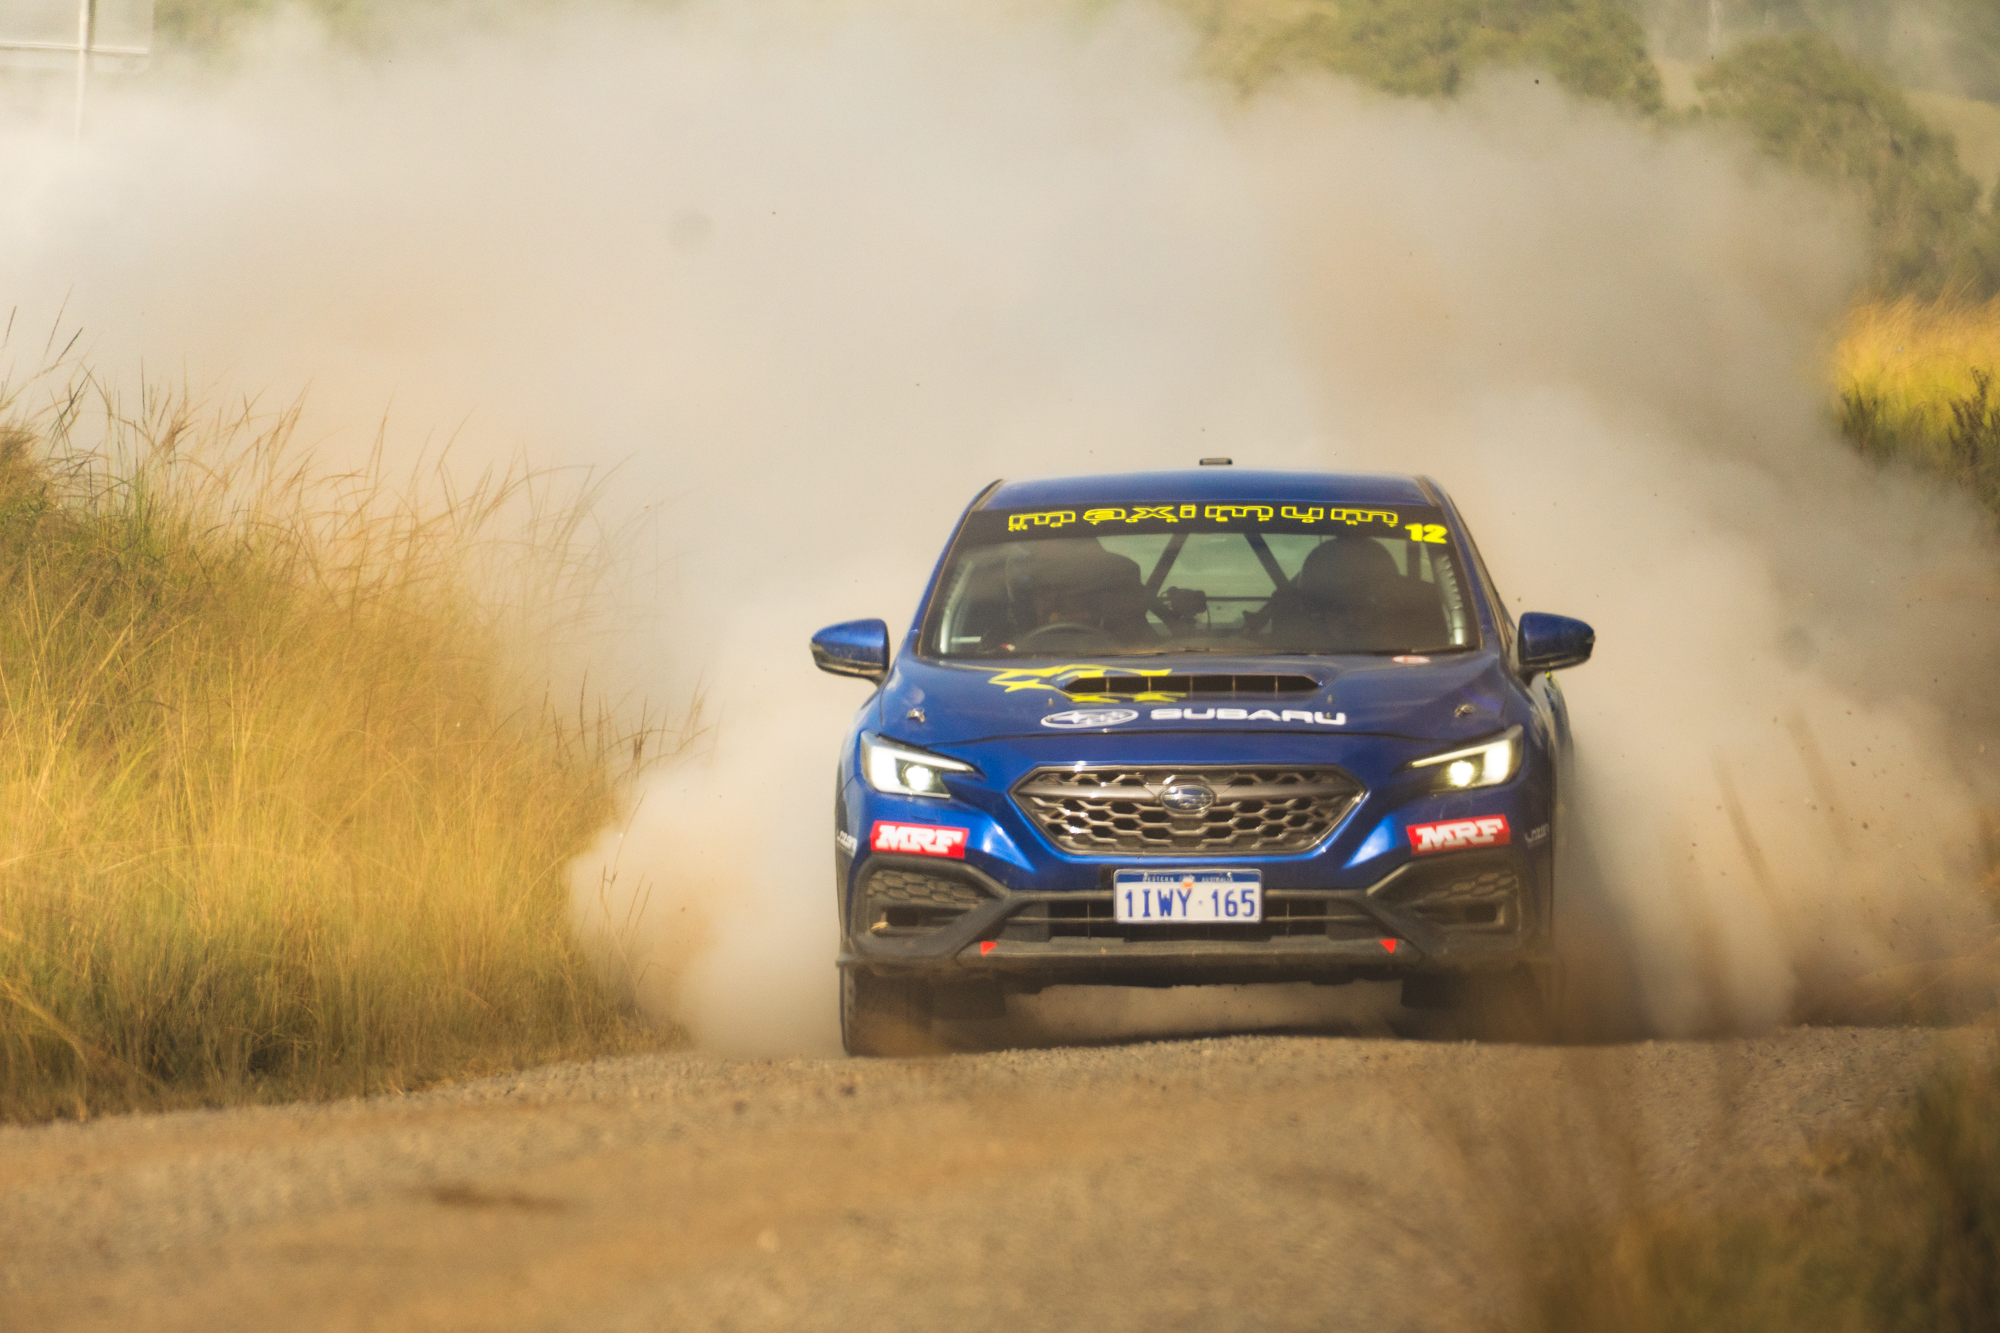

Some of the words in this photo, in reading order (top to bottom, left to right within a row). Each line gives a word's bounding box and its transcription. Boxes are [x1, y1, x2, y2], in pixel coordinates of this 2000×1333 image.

[1008, 504, 1398, 527] maximum
[1405, 523, 1447, 544] 12
[1150, 708, 1346, 726] SUBARU
[875, 824, 963, 854] MRF
[1415, 818, 1504, 851] MRF
[1125, 888, 1192, 917] 1IWY
[1211, 888, 1255, 917] 165
